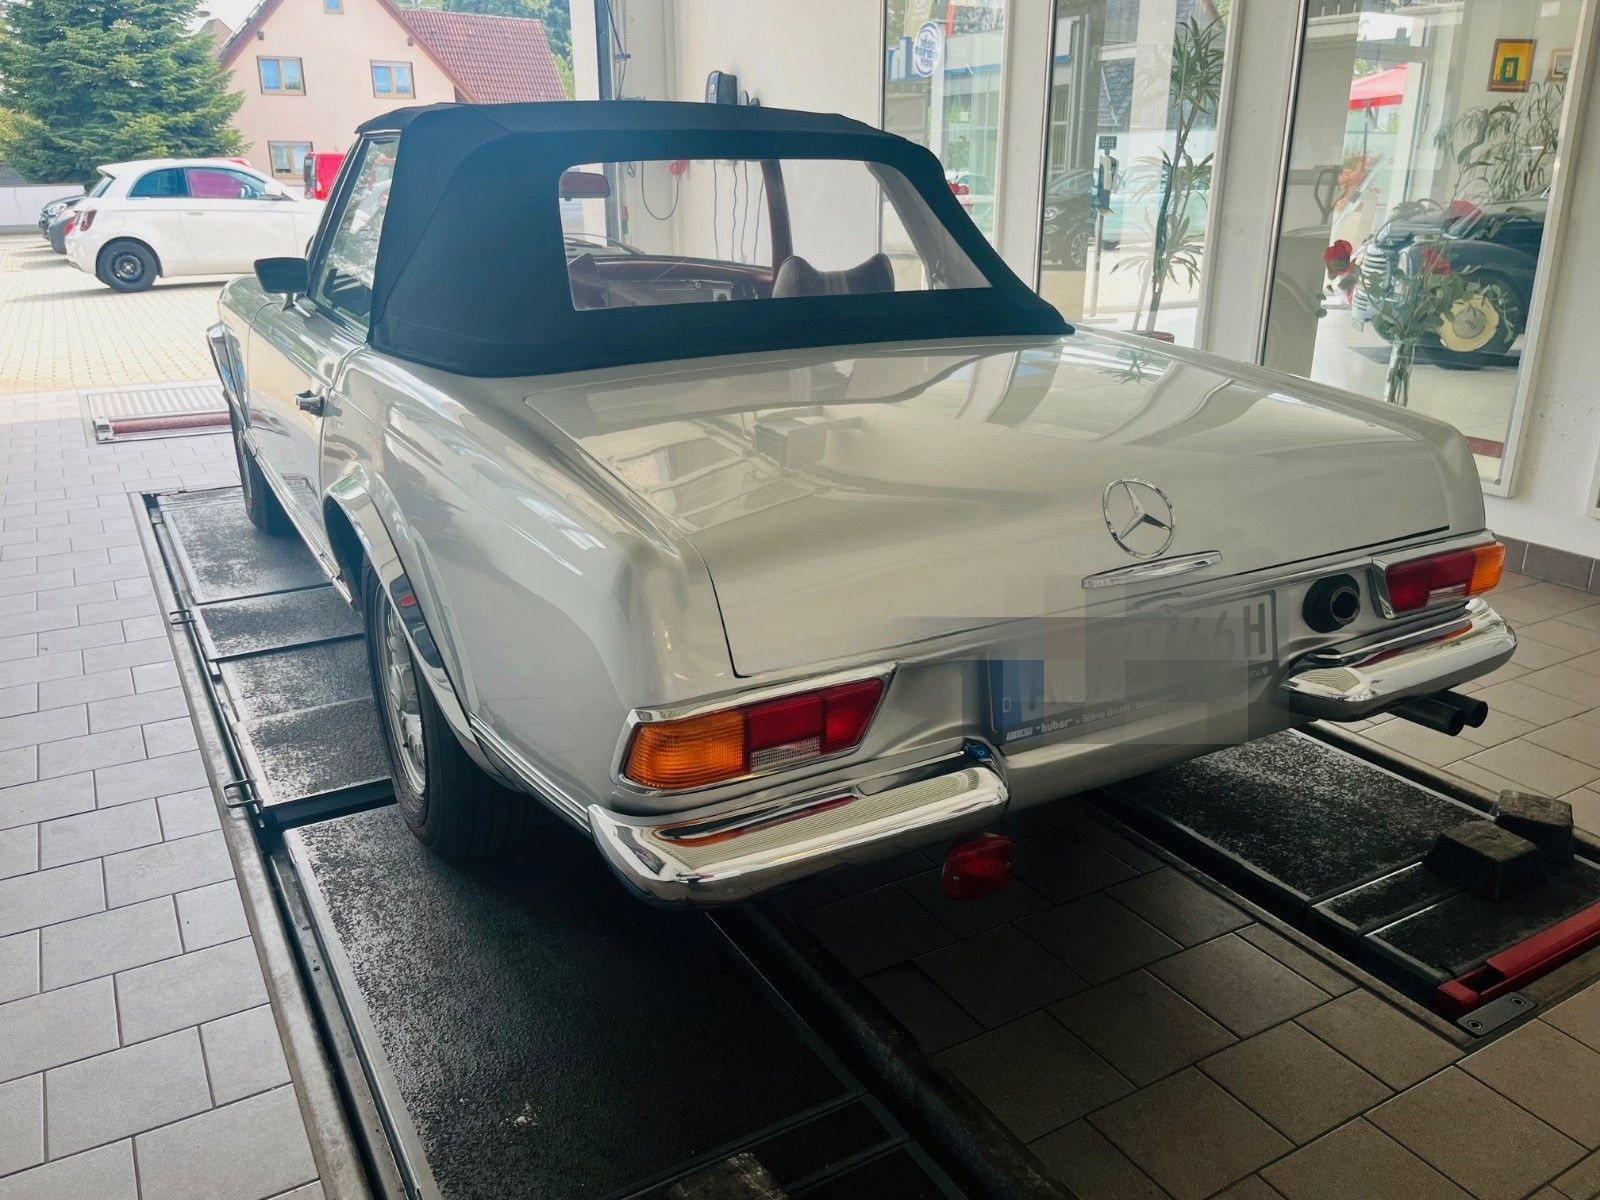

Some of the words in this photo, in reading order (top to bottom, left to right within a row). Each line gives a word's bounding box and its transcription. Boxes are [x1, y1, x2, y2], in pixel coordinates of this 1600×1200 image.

[1002, 697, 1012, 713] D
[1081, 711, 1106, 723] Söhne
[1107, 703, 1131, 717] GmbH
